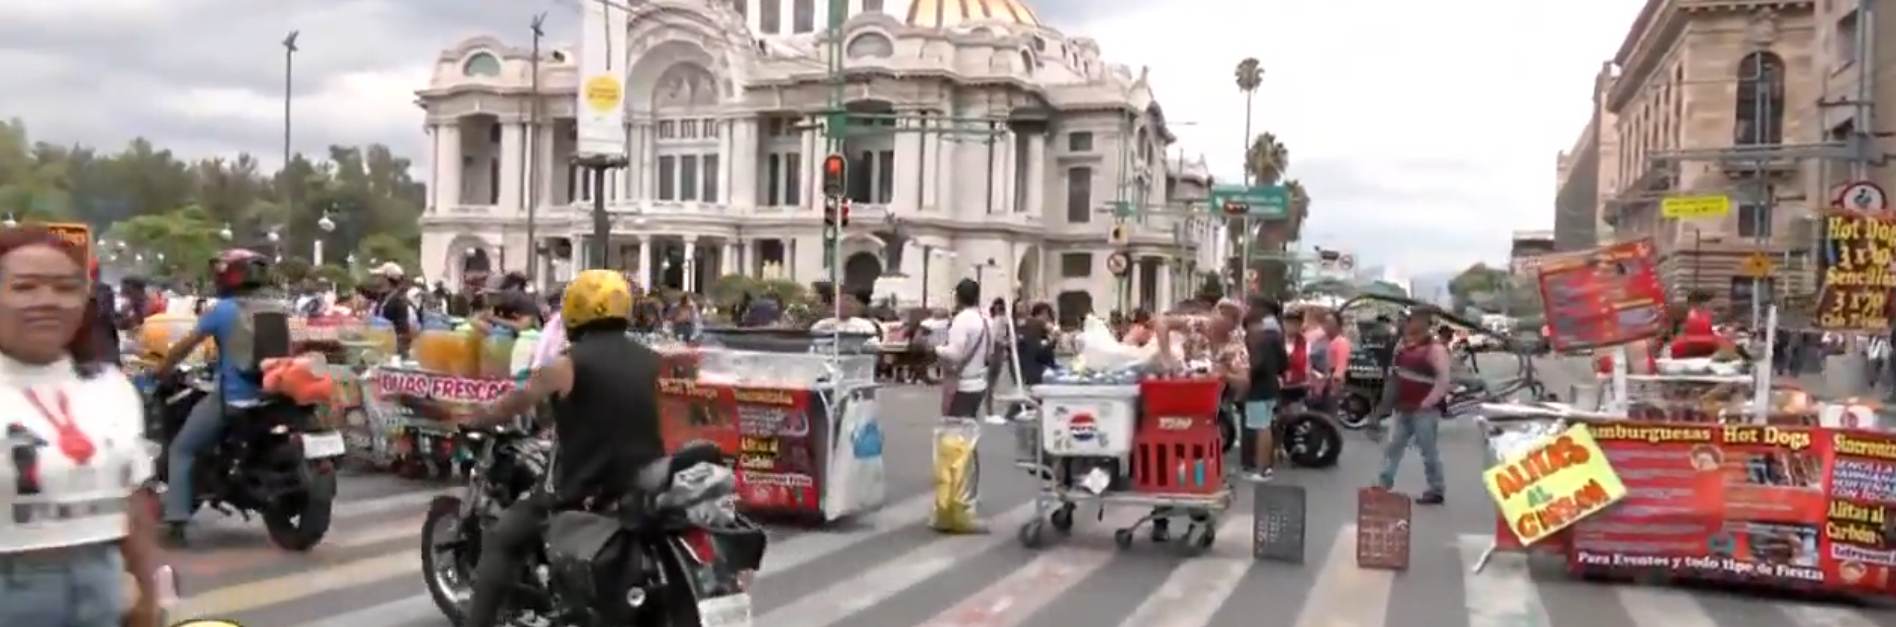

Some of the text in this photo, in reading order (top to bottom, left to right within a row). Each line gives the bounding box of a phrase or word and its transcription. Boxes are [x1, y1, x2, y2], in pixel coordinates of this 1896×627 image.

[1589, 423, 1811, 450] amburguesas Hot Dogs
[1578, 551, 1610, 565] Para
[1613, 552, 1669, 567] Eventos
[1685, 553, 1719, 569] todo
